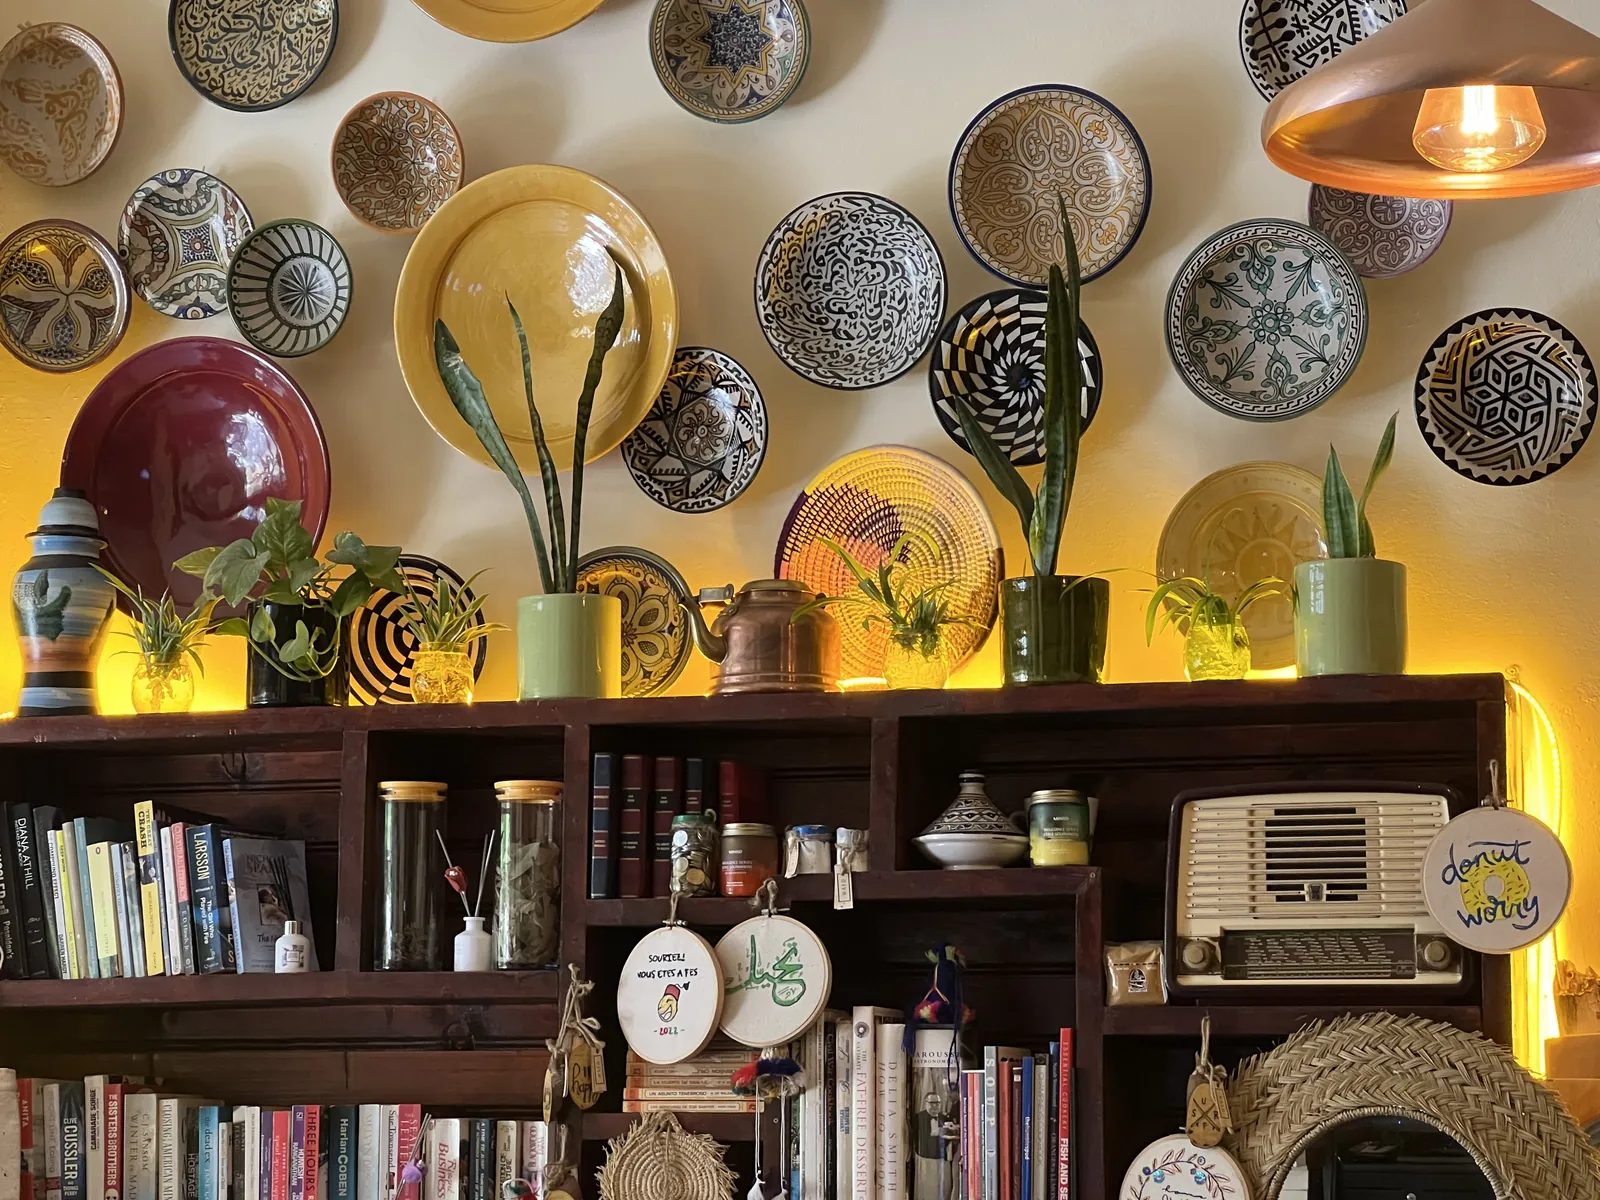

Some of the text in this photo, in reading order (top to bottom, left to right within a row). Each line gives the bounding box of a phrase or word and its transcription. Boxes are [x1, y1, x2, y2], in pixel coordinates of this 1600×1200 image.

[138, 810, 147, 848] CRASH
[17, 817, 34, 890] DIANA ATHILL
[193, 832, 210, 880] LARSSON
[1440, 839, 1532, 886] donut
[1456, 896, 1541, 931] worry
[3, 920, 14, 960] Poseidon's
[636, 969, 656, 979] VOUS
[676, 969, 683, 978] A
[684, 967, 698, 978] FES
[659, 1026, 679, 1036] 2022
[826, 1033, 834, 1055] Civil
[1061, 1040, 1069, 1088] ESSENTIAL
[21, 1099, 29, 1128] ANITA
[826, 1078, 834, 1126] Cookbook
[986, 1058, 996, 1127] SOUP
[63, 1117, 78, 1125] CLIVE
[108, 1100, 118, 1139] SISTERS
[130, 1114, 139, 1162] WINTER
[162, 1103, 172, 1139] CLOSING
[204, 1116, 213, 1164] the dead ex
[856, 1071, 868, 1195] FAT-FREE DESSERT
[877, 1061, 886, 1193] HOW TO COOK
[888, 1061, 898, 1192] DELIA SMITH
[63, 1123, 79, 1180] CUSSLER
[107, 1139, 117, 1186] BROTHERS
[142, 1131, 150, 1171] SANSOM
[162, 1142, 173, 1184] AMERICAN
[306, 1110, 317, 1192] THREE HOURS
[388, 1125, 397, 1169] Townsend
[400, 1120, 409, 1168] LETTER
[1060, 1137, 1069, 1161] FISH
[187, 1153, 195, 1198] HOSTAGE
[438, 1142, 449, 1199] Business
[1060, 1163, 1069, 1185] AND
